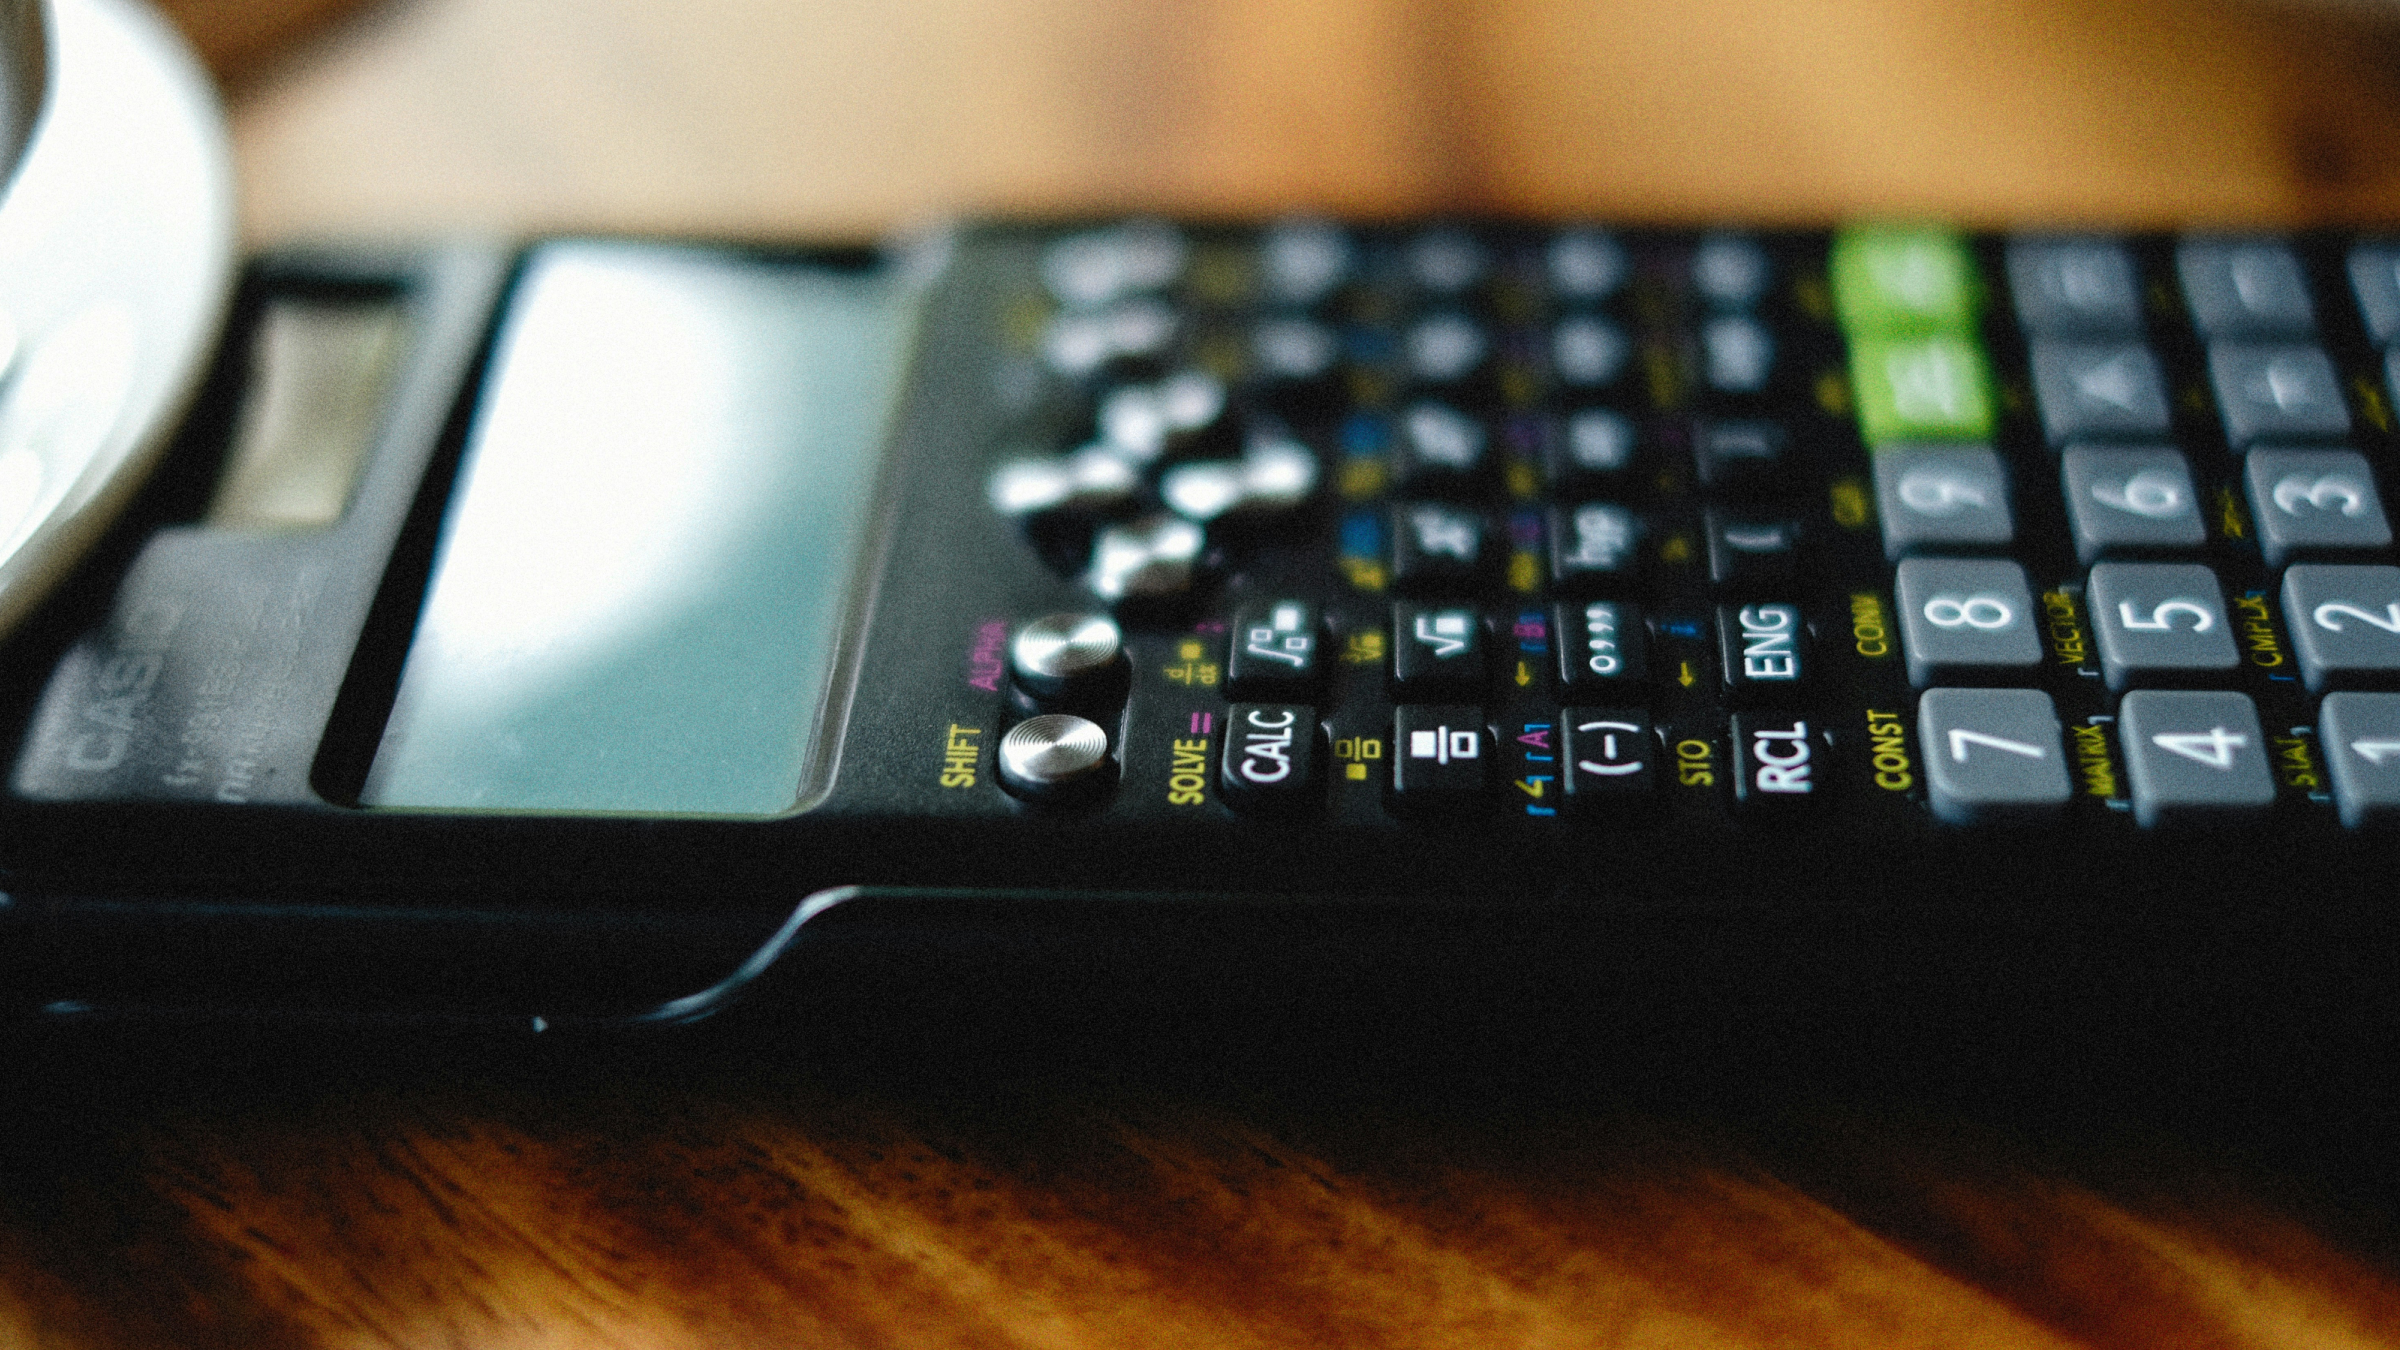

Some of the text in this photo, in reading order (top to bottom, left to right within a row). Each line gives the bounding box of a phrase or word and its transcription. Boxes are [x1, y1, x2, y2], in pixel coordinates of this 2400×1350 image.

[1900, 473, 1988, 516] 9
[2092, 473, 2177, 517] 6
[2272, 474, 2361, 517] 3
[1923, 597, 2011, 630] 8
[2118, 600, 2214, 633] 5
[2314, 602, 2400, 633] 2
[967, 621, 1006, 692] ALPHA
[1739, 604, 1799, 679] ENG
[940, 723, 982, 788] SHIFT
[1241, 710, 1296, 783] CALC
[1677, 739, 1715, 787] STO
[1753, 721, 1813, 794] RCL
[1867, 708, 1914, 791] CONST
[1947, 728, 2046, 763] 7
[2152, 727, 2248, 770] 4
[1168, 739, 1208, 805] SOLVE
